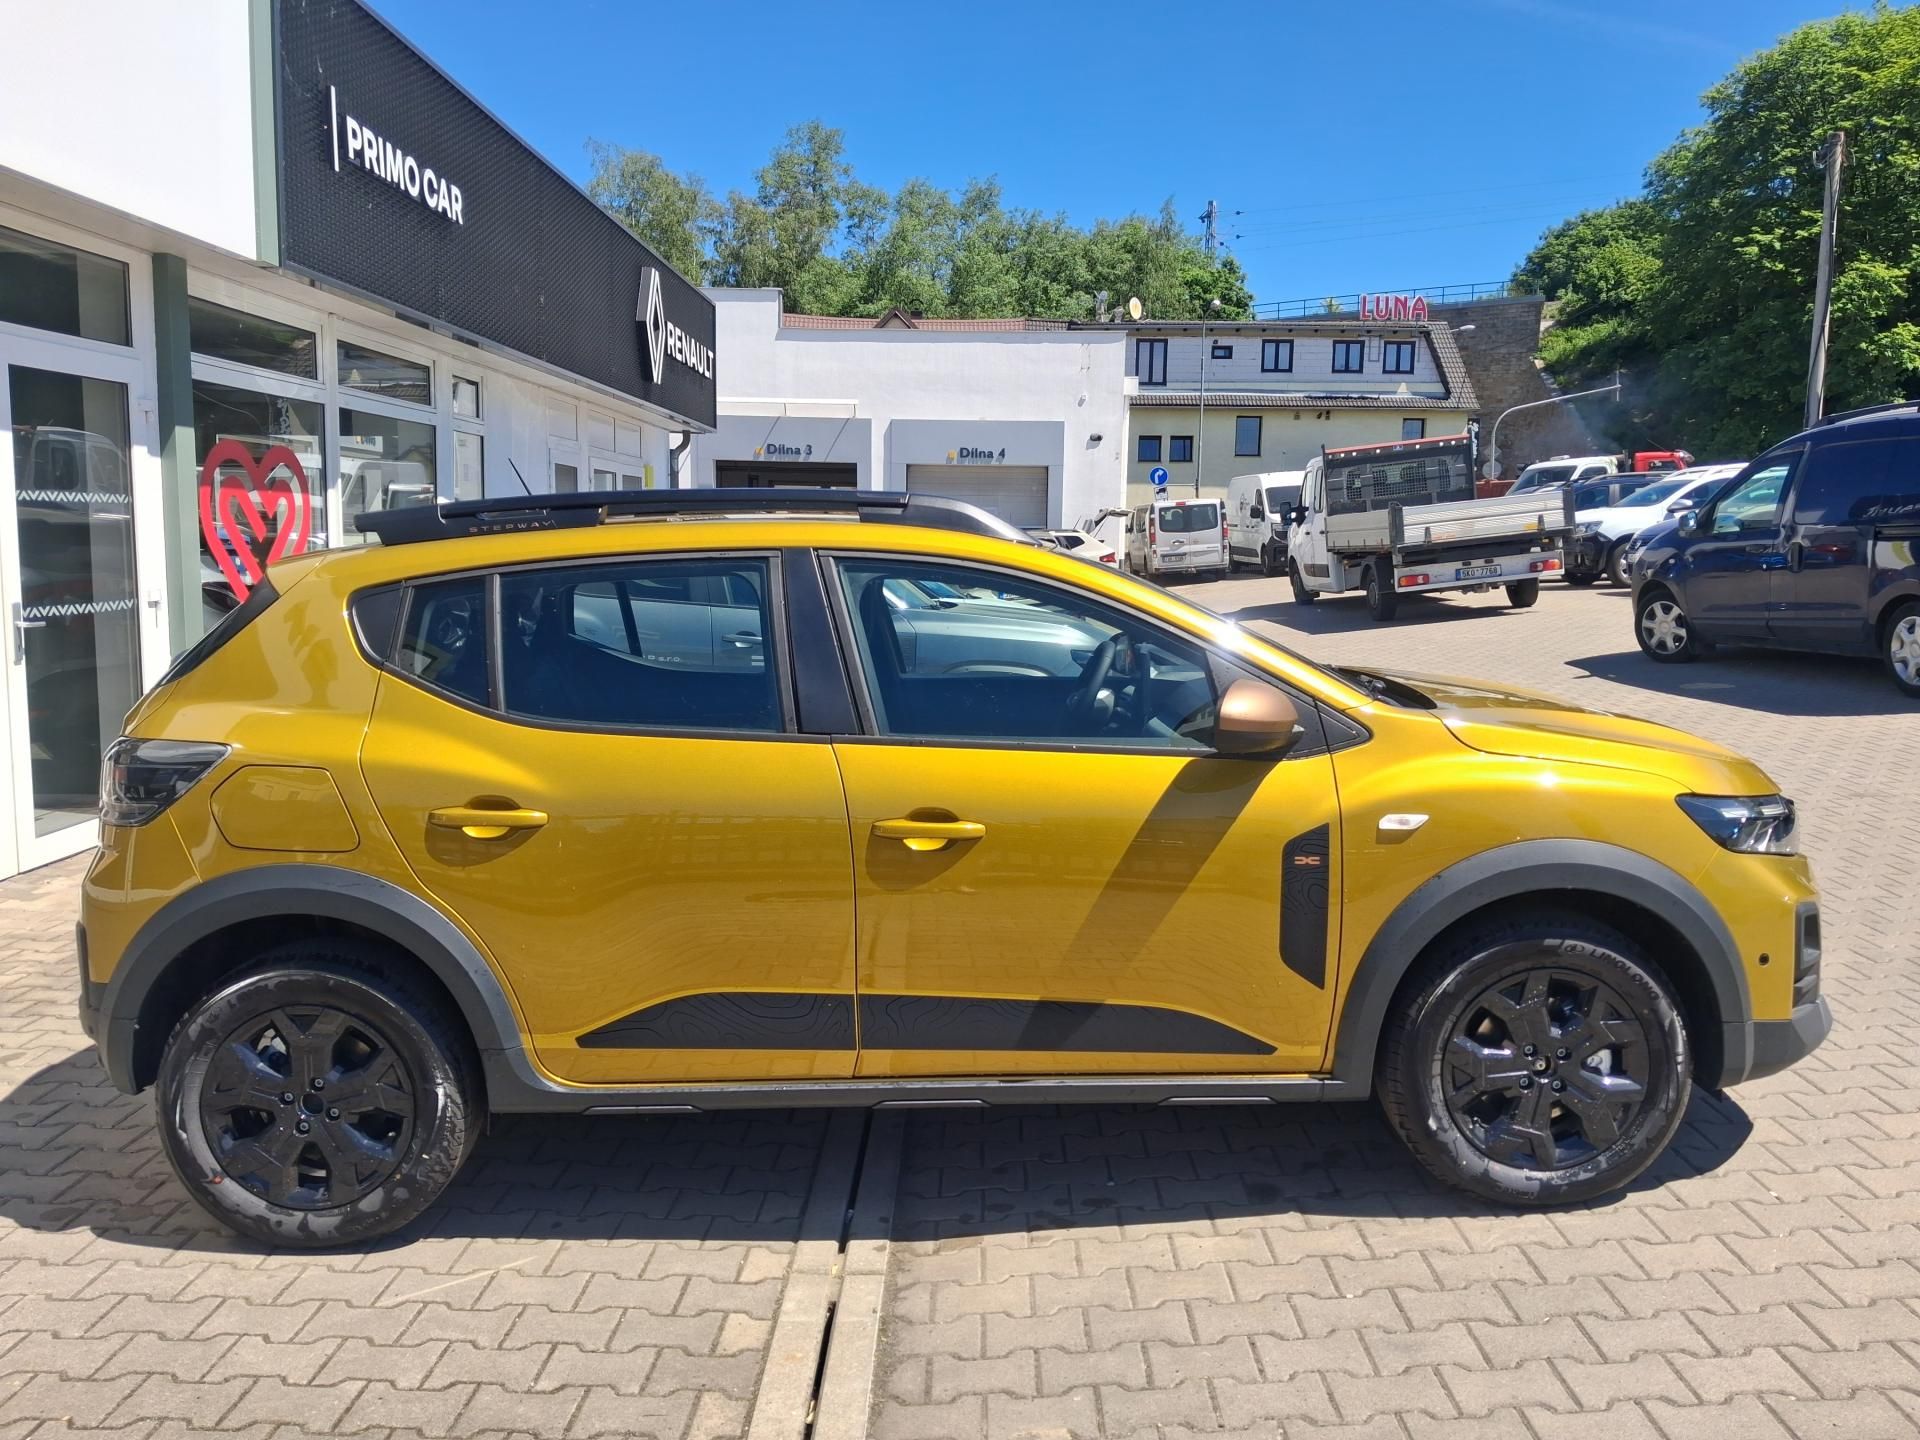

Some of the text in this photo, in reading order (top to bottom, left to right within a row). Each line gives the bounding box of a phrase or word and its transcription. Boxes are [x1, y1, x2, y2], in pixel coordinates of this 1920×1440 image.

[345, 114, 464, 225] PRIMO CAR
[1360, 294, 1428, 321] LUNA
[666, 320, 715, 380] RENAULT
[804, 444, 813, 456] 3
[997, 447, 1006, 459] 4
[468, 520, 552, 533] STEPWAY
